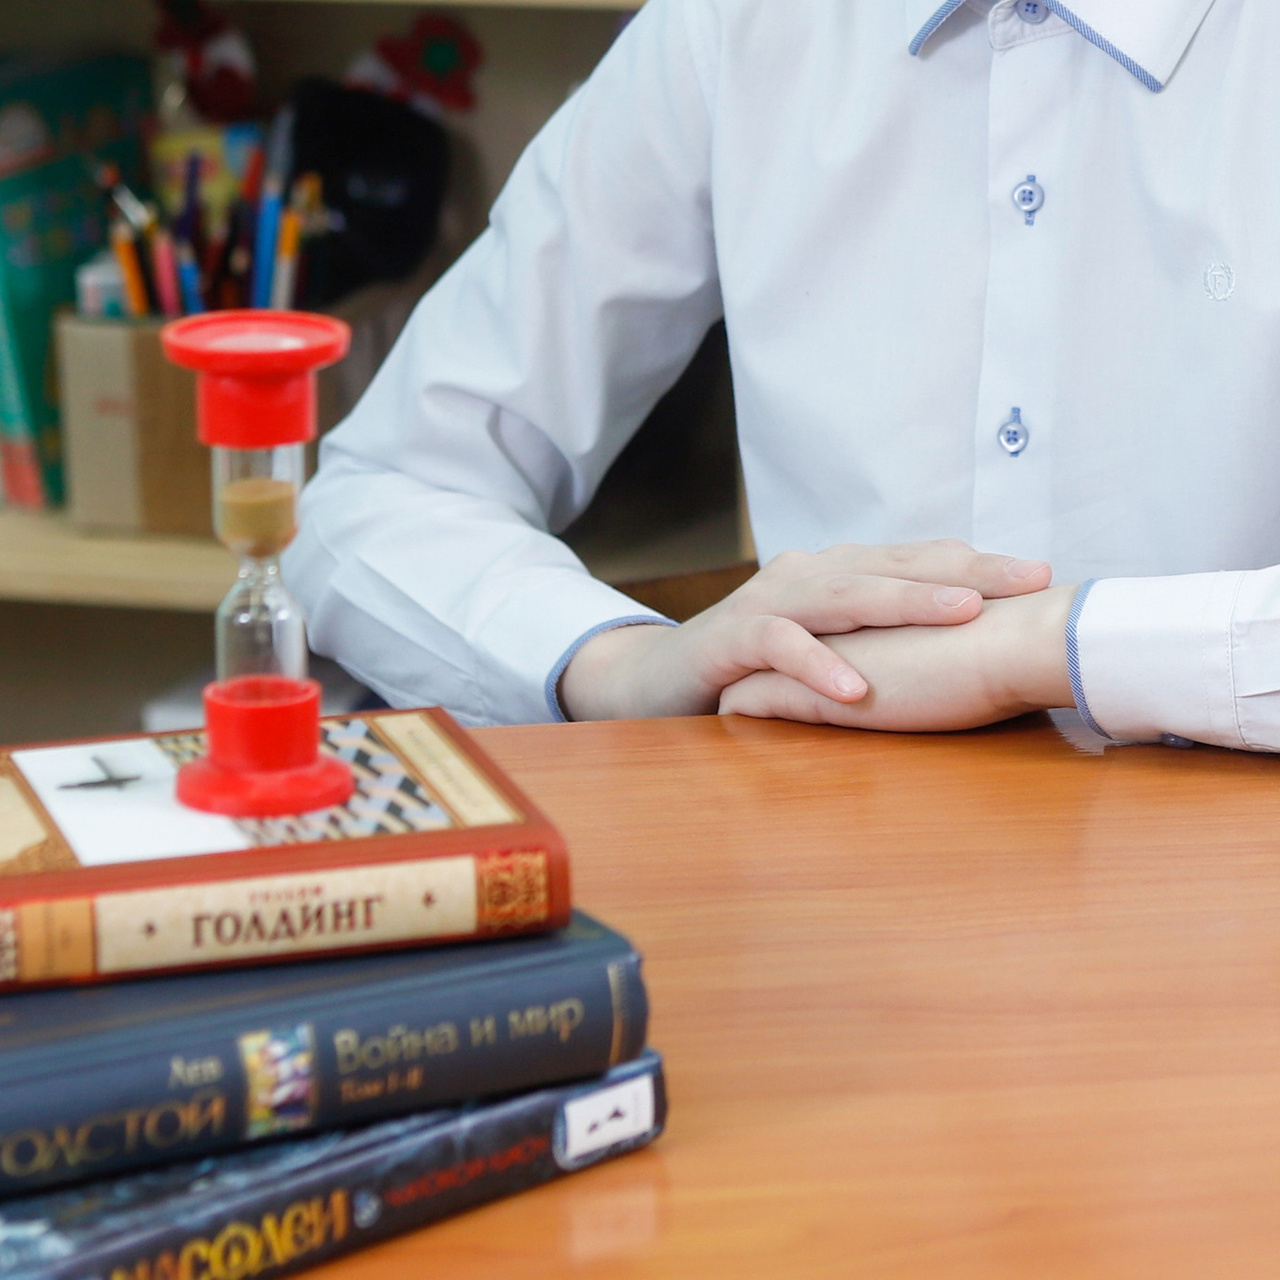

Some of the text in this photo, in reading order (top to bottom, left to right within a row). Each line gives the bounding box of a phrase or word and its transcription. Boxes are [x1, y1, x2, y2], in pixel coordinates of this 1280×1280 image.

[191, 894, 383, 948] ГОЛДИНГ
[333, 996, 585, 1075] Война и мир
[168, 1055, 225, 1090] Лев
[0, 1086, 228, 1179] ОЛСТОЙ
